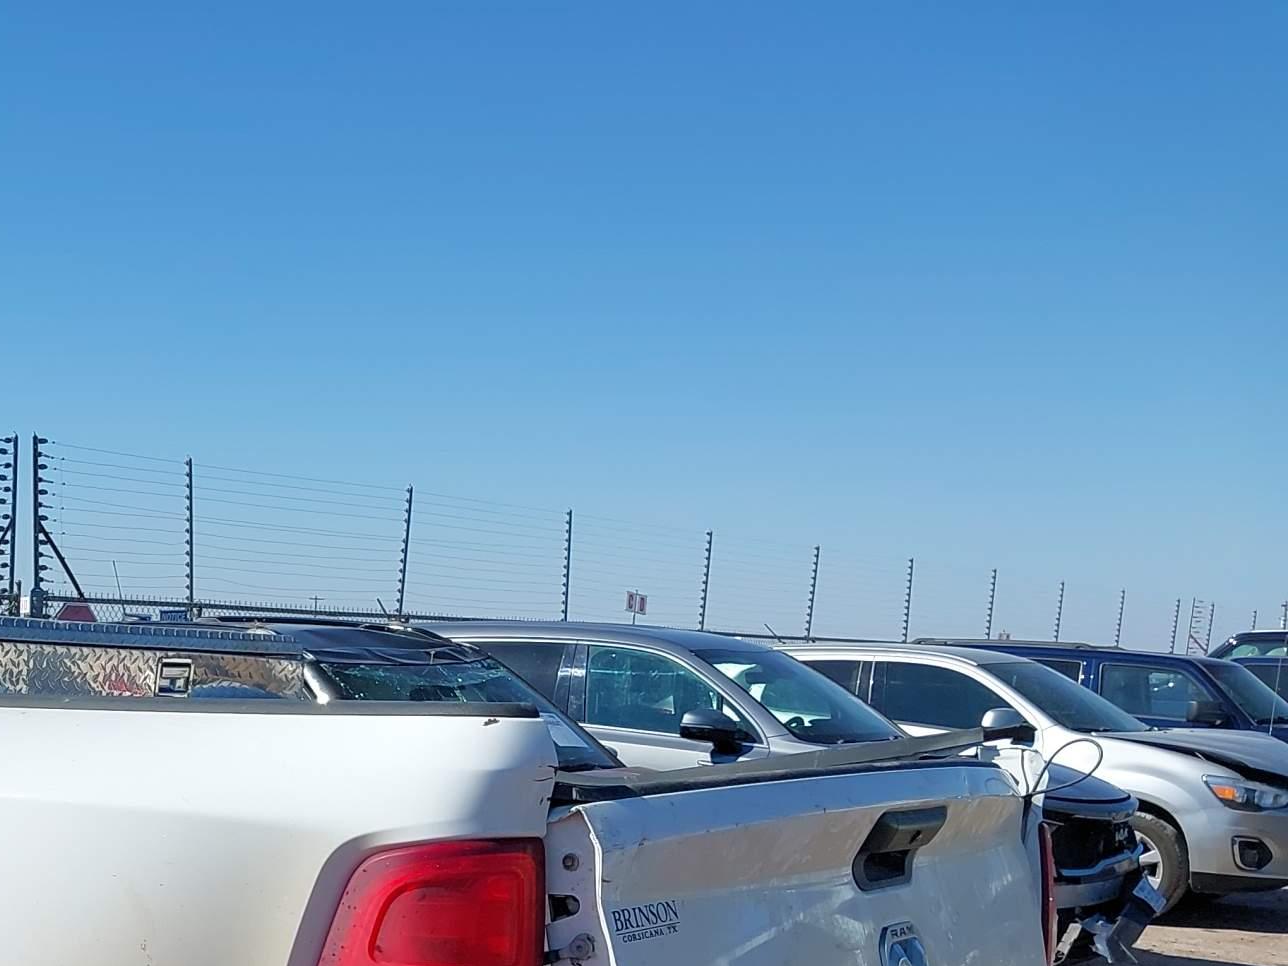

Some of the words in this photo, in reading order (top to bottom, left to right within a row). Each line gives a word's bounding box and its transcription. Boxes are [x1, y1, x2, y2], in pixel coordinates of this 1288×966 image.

[611, 900, 680, 932] BRINSON
[667, 926, 678, 934] TX
[890, 925, 914, 939] RAM
